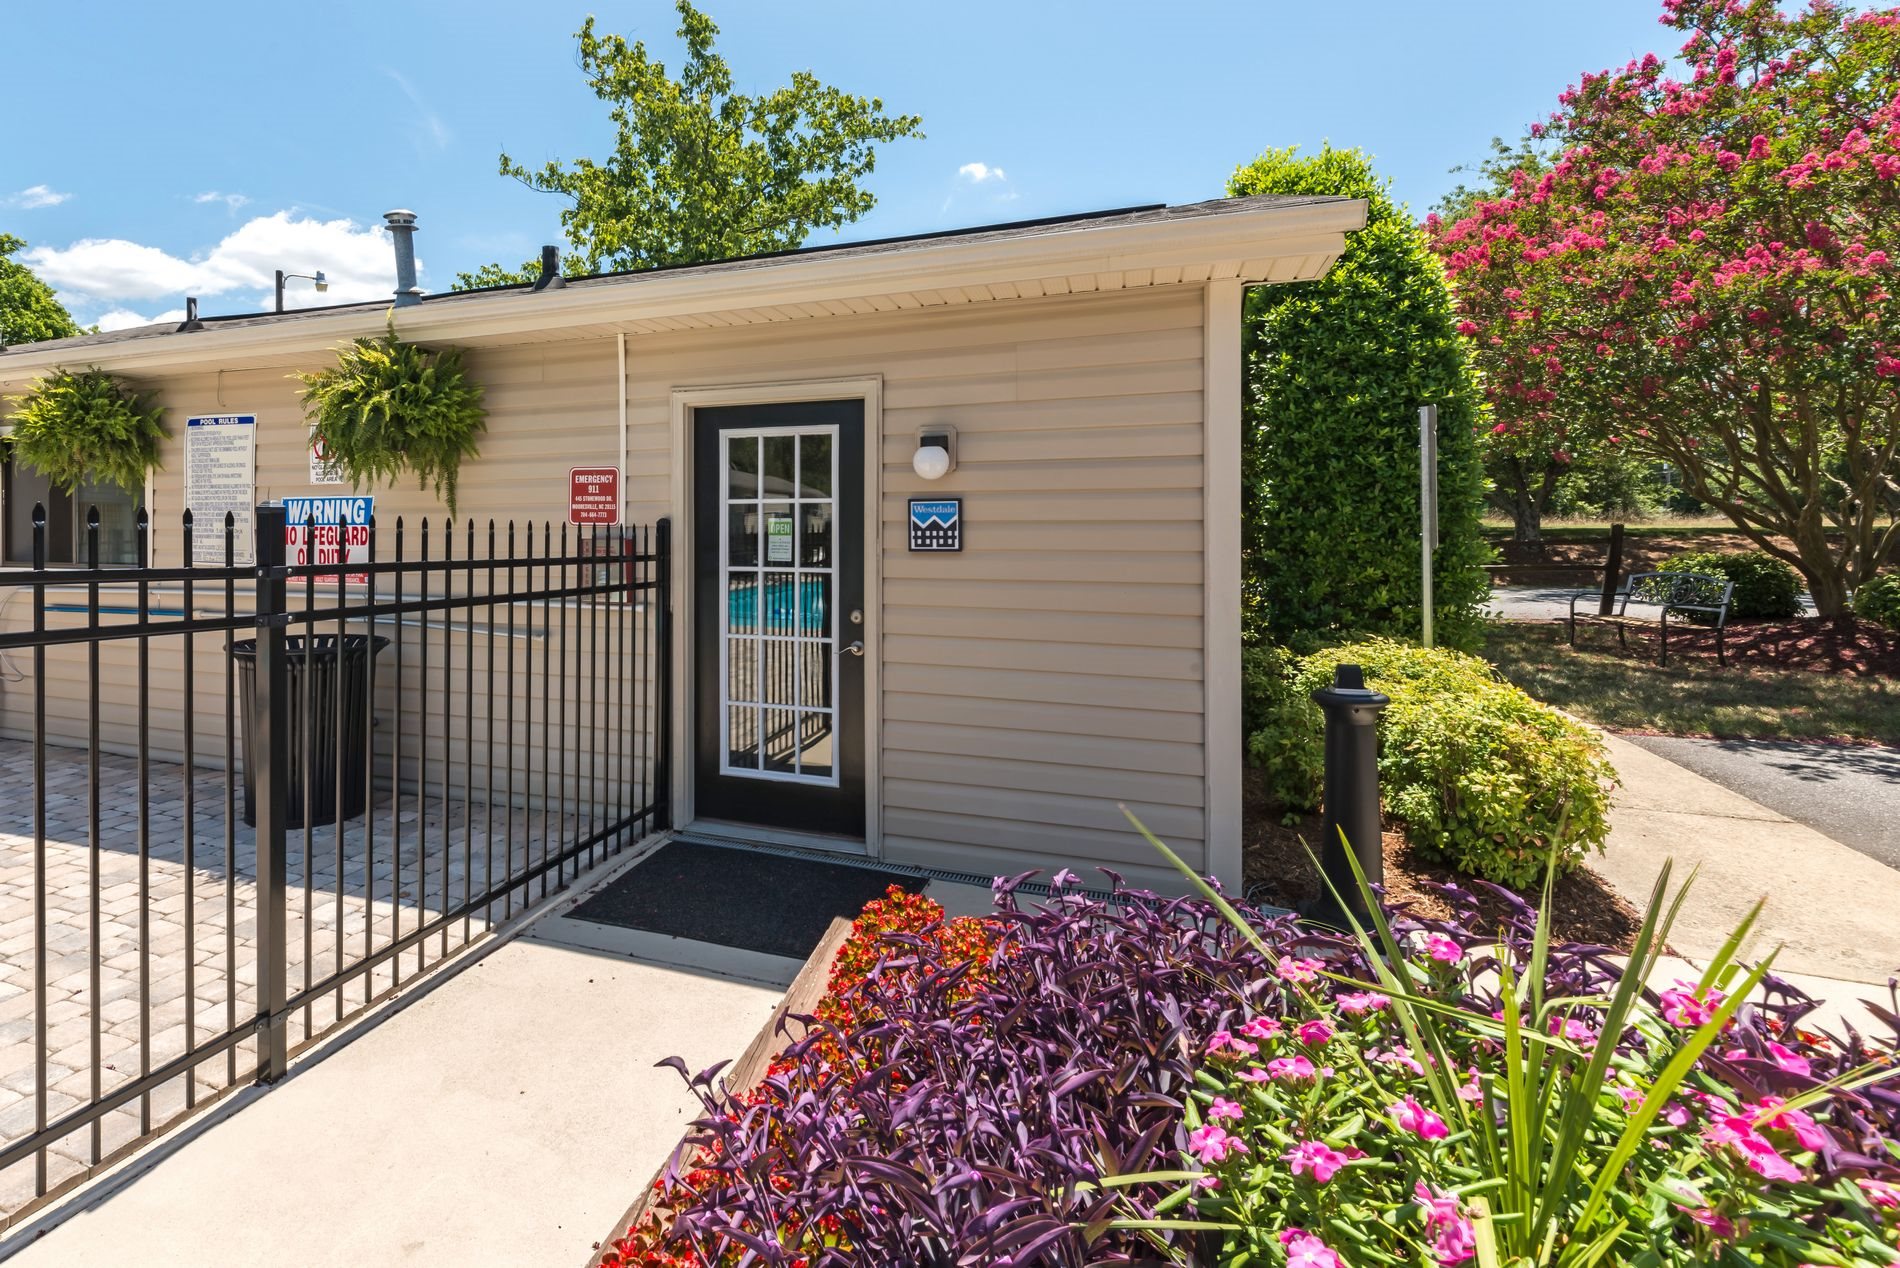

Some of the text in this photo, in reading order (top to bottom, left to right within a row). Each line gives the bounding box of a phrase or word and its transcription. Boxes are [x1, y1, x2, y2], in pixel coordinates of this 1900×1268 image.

[575, 475, 614, 484] EMERGENCY
[587, 485, 600, 493] 911
[288, 499, 366, 524] WARNING
[914, 504, 956, 513] Westdale
[770, 523, 790, 534] OPEN
[302, 526, 369, 546] LFEGUARD
